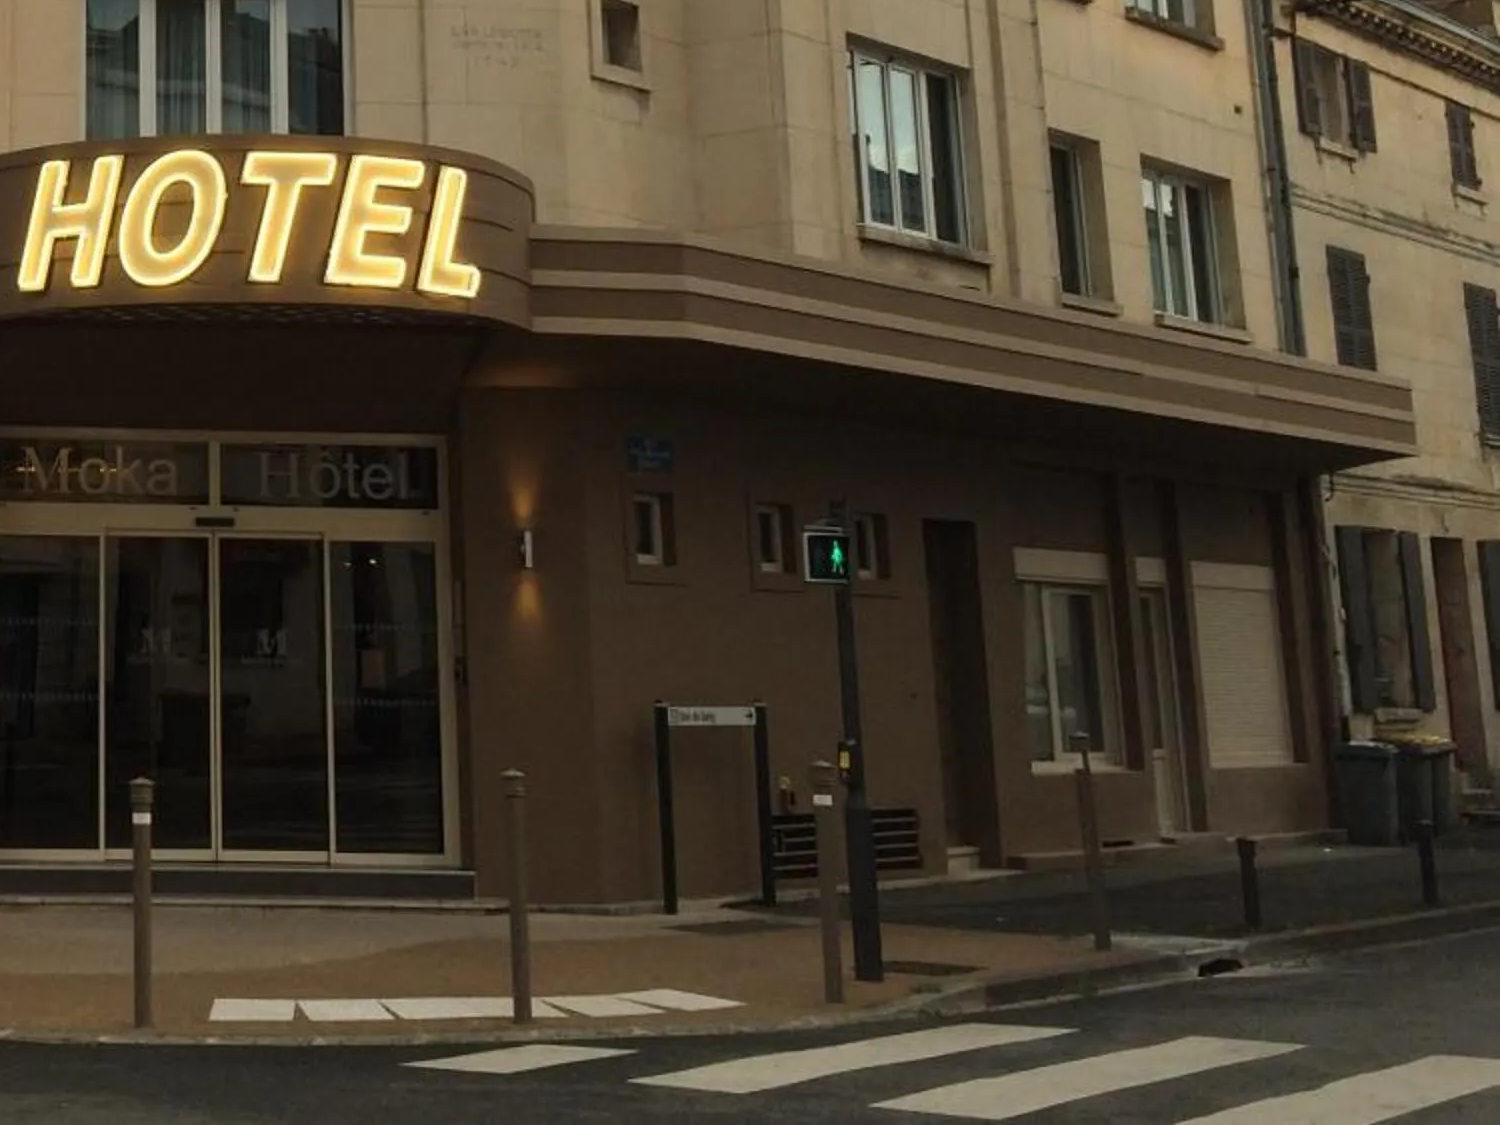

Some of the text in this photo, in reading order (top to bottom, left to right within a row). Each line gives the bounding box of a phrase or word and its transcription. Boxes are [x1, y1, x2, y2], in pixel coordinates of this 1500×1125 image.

[17, 150, 481, 298] HOTEL
[23, 446, 414, 501] Moka Hôtel
